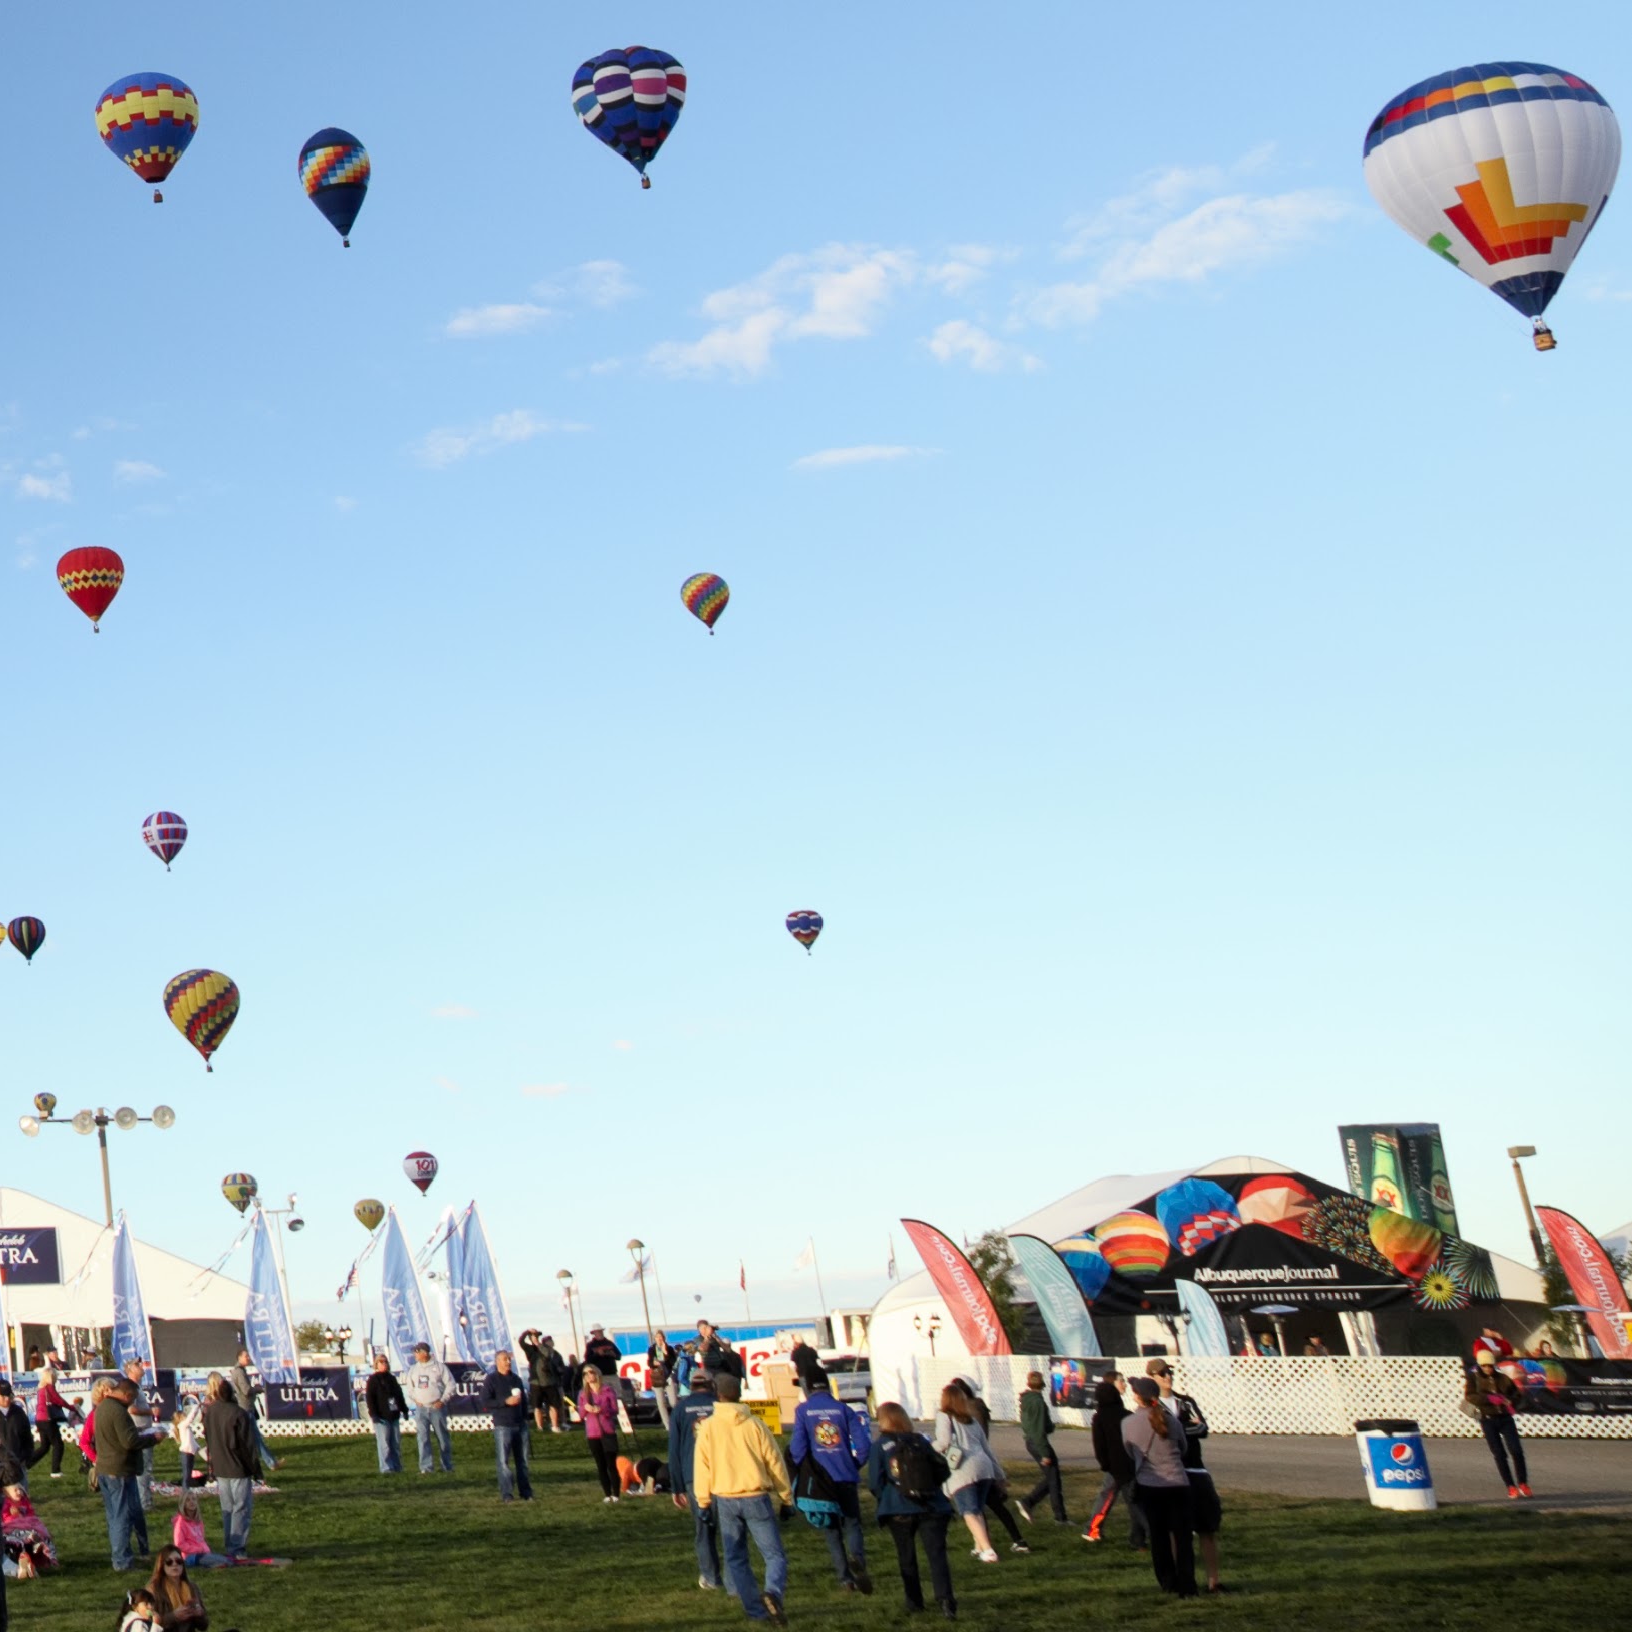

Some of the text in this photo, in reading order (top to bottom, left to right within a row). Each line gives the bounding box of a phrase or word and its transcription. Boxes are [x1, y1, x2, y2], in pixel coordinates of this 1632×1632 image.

[1251, 1293, 1310, 1302] FIREWORKS
[1315, 1292, 1361, 1301] SPONSOR
[279, 1387, 339, 1401] ULTRA
